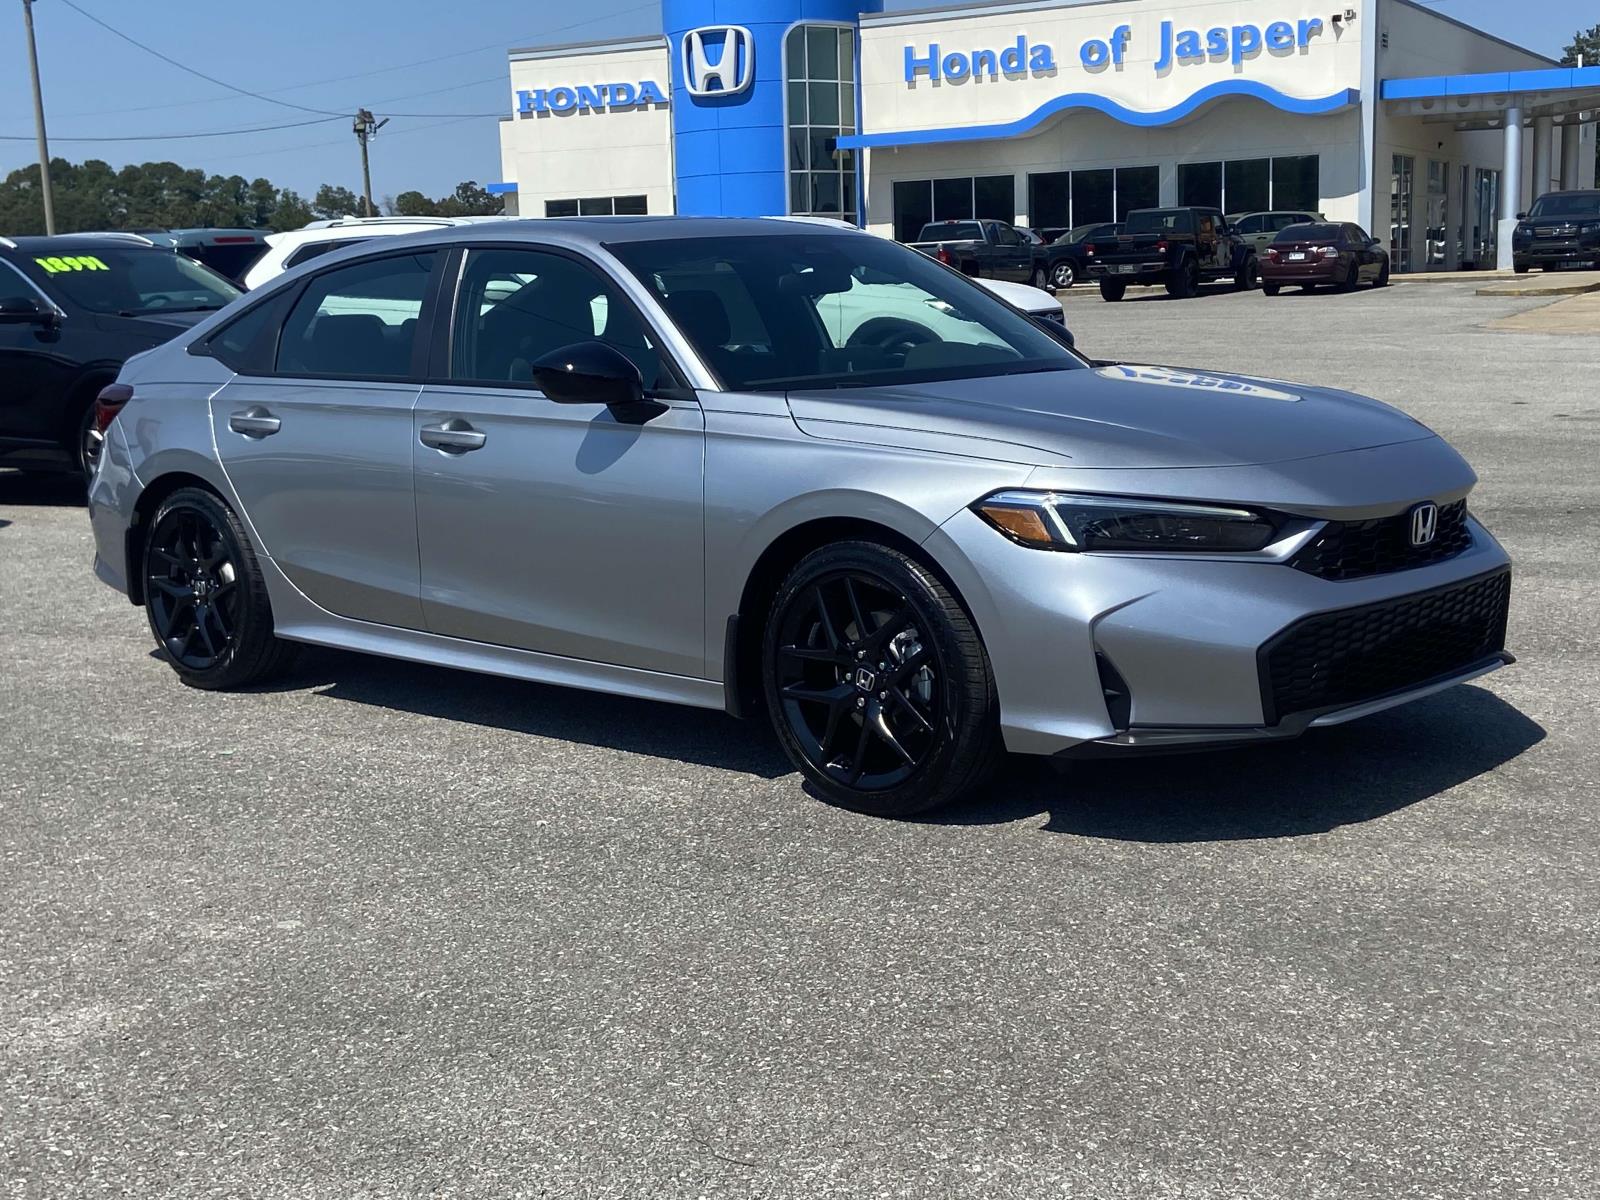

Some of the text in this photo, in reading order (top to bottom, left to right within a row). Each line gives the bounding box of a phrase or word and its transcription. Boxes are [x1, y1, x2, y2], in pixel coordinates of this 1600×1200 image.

[904, 18, 1324, 82] Honda of Jasper
[516, 81, 669, 113] HONDA
[36, 256, 110, 273] 18991
